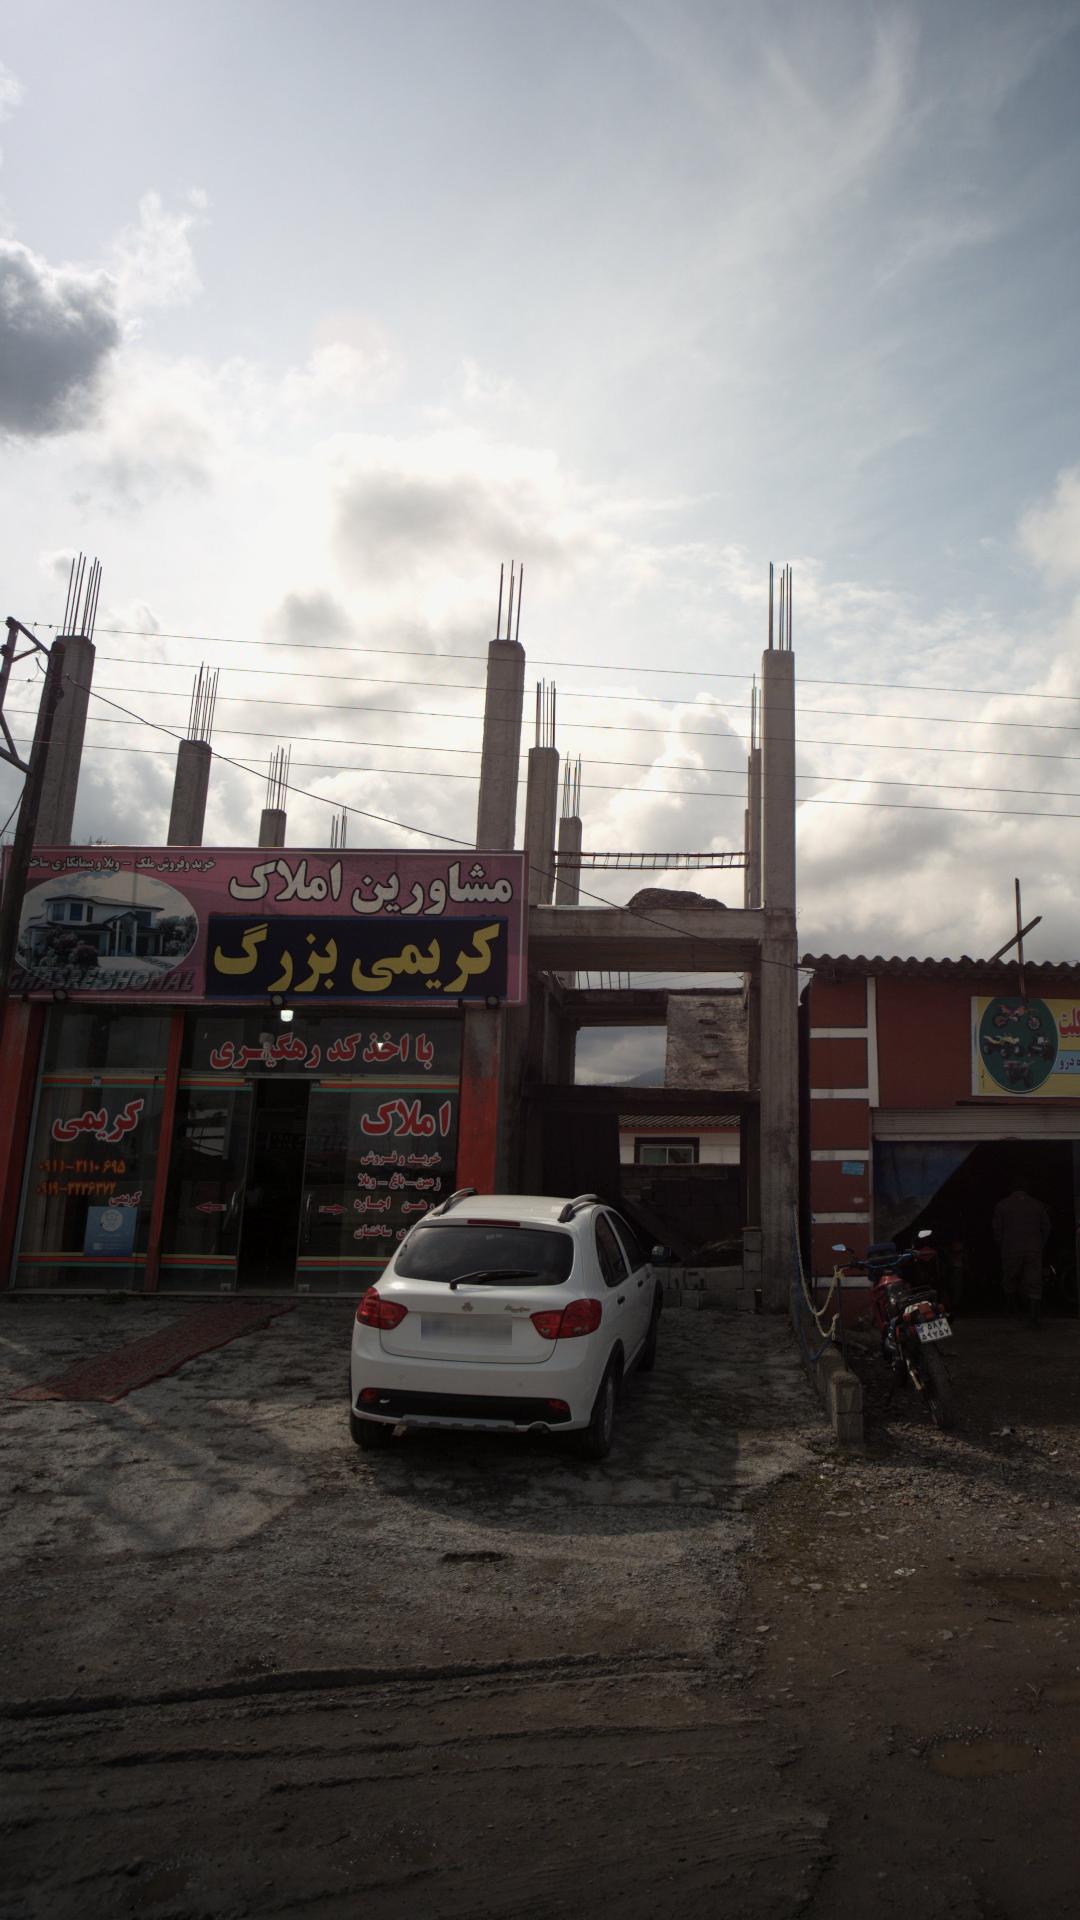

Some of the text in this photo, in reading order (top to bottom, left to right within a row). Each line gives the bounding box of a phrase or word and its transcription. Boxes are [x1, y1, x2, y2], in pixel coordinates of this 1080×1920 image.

[228, 860, 513, 916] مشاورین املاک
[213, 923, 503, 993] کریمی بزرگ
[210, 1032, 434, 1070] با اخذ کد رهگیری
[52, 1098, 145, 1142] کریمی
[360, 1097, 451, 1137] املاک
[360, 1151, 398, 1166] فروش
[407, 1151, 442, 1168] خرید
[108, 1191, 143, 1208] کریمی
[354, 1196, 392, 1213] اجاره
